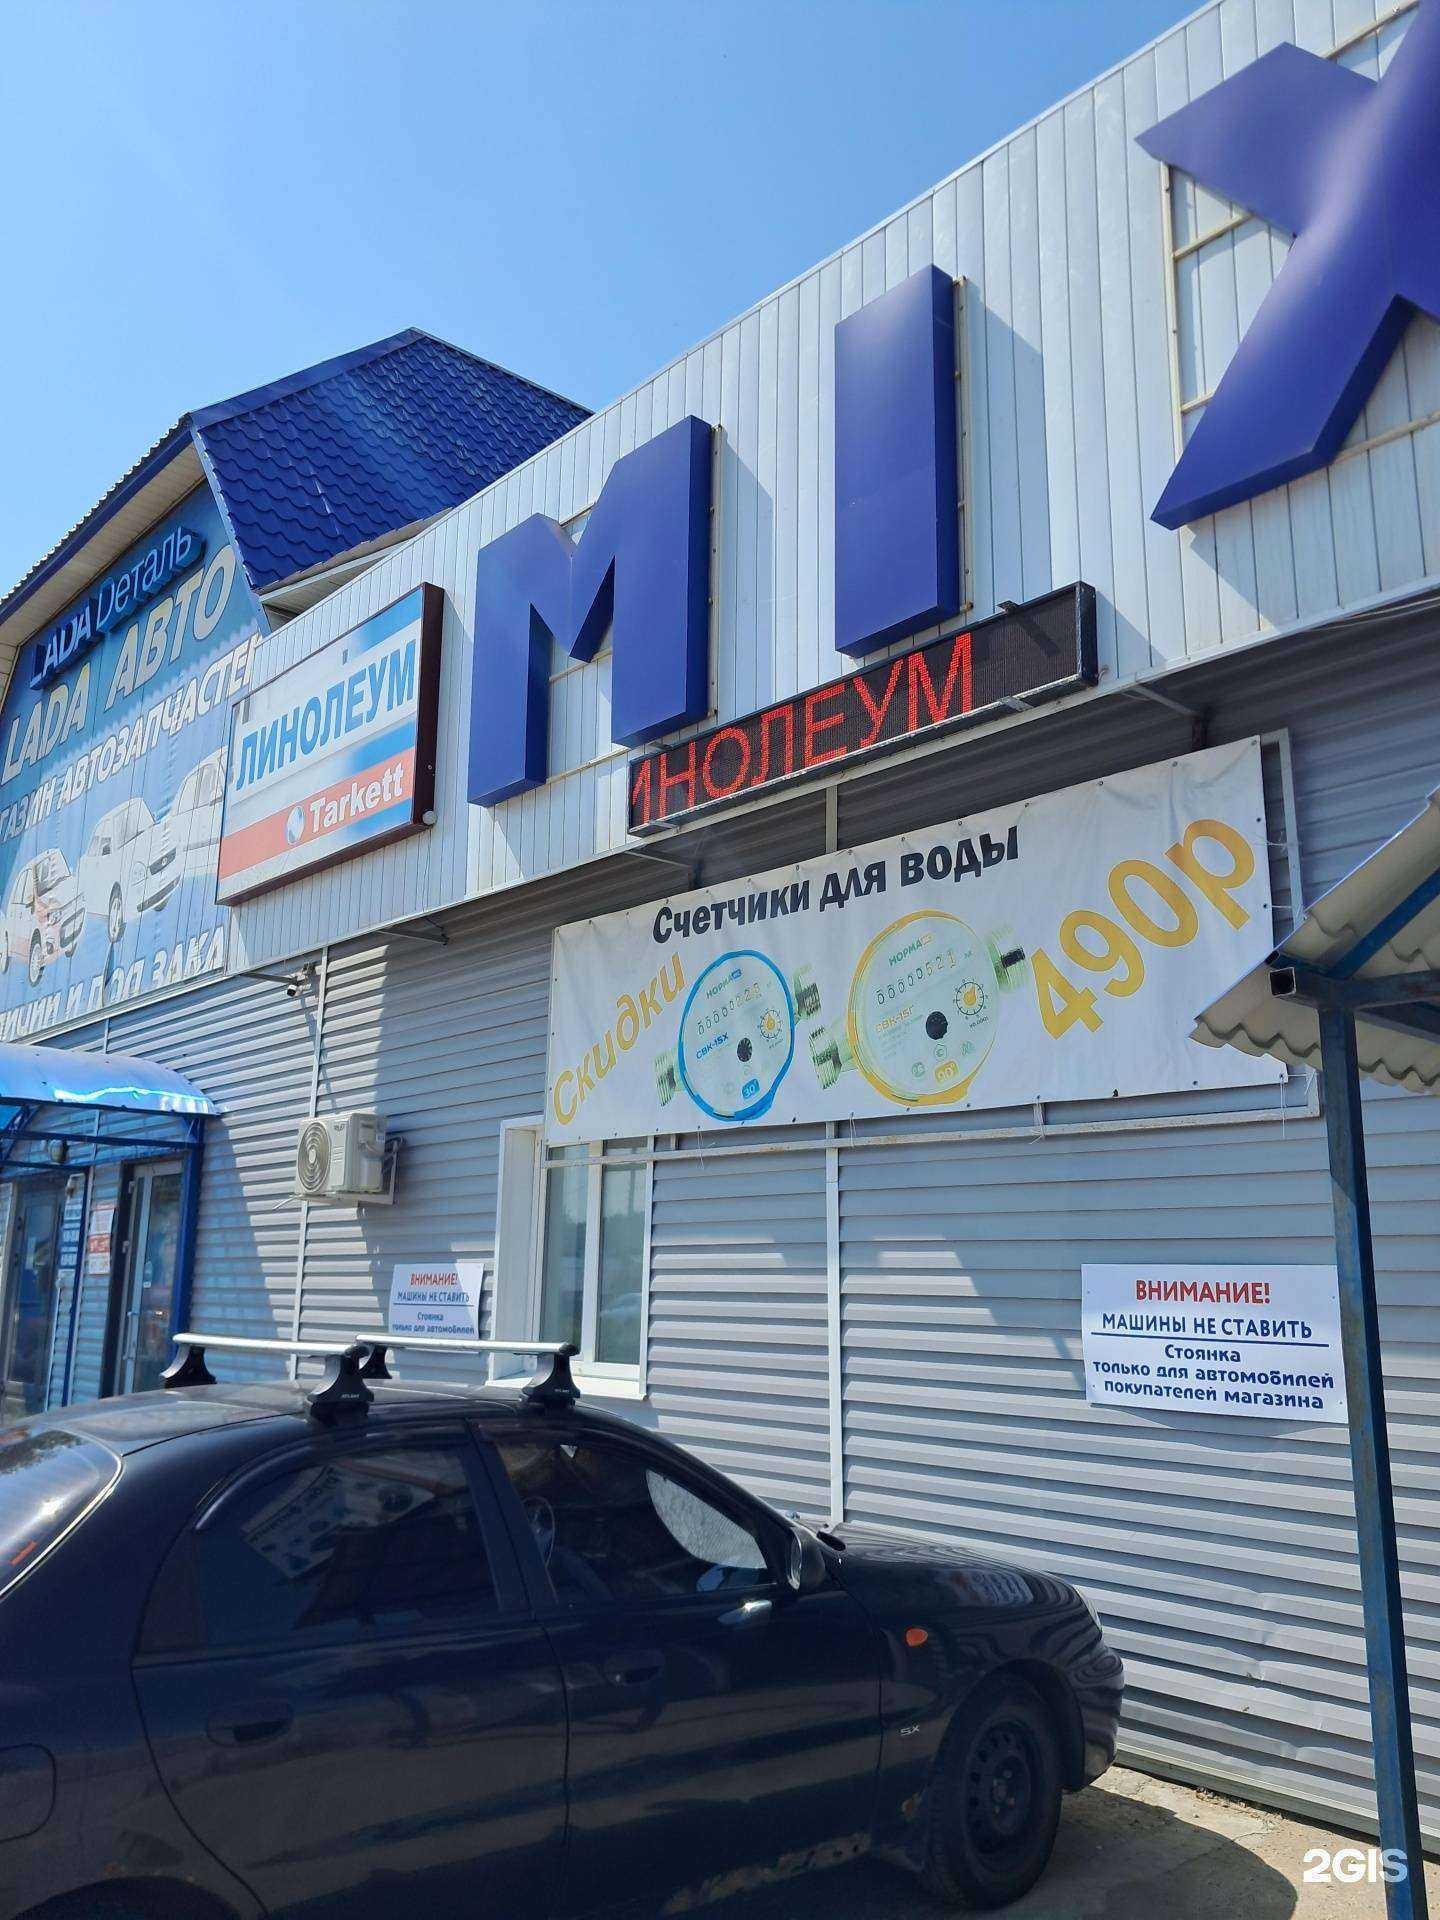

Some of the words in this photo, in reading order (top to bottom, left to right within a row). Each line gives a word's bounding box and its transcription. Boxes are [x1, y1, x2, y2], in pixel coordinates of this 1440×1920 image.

[29, 600, 92, 690] LADA
[1, 661, 92, 788] LADA
[103, 544, 237, 714] АВТО
[236, 638, 417, 791] ЛИНОЛЕУМ
[308, 761, 405, 833] Tarkett
[652, 878, 811, 944] Счетчики
[819, 860, 887, 912] для
[551, 951, 687, 1126] Скидки
[410, 1272, 458, 1286] ВНИМАНИЕ!
[1135, 1279, 1271, 1304] ВНИМАНИЕ!
[397, 1290, 428, 1302] МАШИНЫ
[428, 1291, 438, 1302] НЕ
[439, 1291, 470, 1303] СТАВИТЬ
[1101, 1313, 1187, 1333] МАШИНЫ
[1194, 1317, 1217, 1335] НЕ
[1221, 1318, 1313, 1339] СТАВИТЬ
[1164, 1344, 1242, 1362] Стоянка
[1092, 1361, 1151, 1376] только
[1156, 1366, 1189, 1380] для
[1195, 1369, 1335, 1389] автомобилей
[1103, 1379, 1217, 1402] покупателей
[1224, 1390, 1324, 1409] магазина
